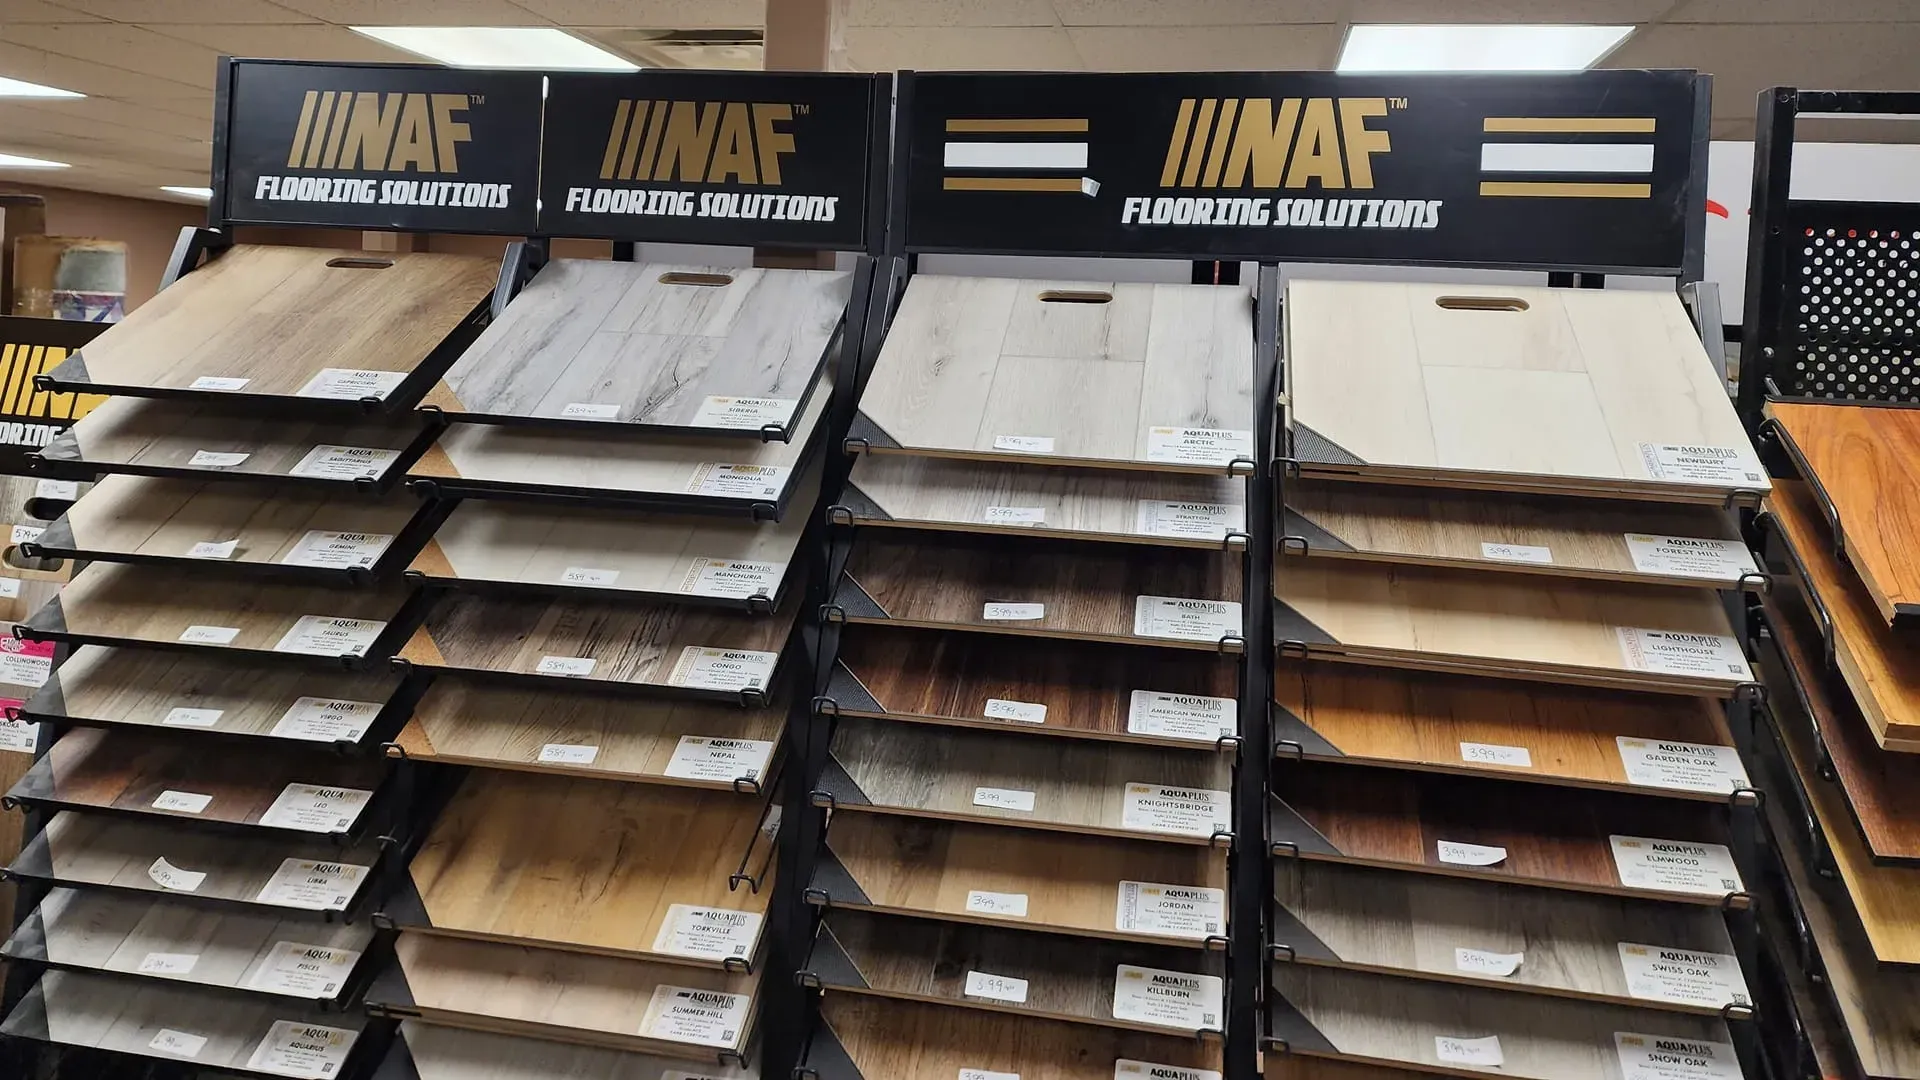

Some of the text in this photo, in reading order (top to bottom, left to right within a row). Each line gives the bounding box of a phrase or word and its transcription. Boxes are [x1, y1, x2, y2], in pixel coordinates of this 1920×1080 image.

[255, 176, 512, 209] FLOORING SOLUTIONS
[565, 188, 839, 222] FLOORING SOLUTIONS
[1121, 197, 1443, 228] FLOORING SOLUTIONS
[1677, 457, 1725, 465] NEWBURY
[718, 473, 762, 482] MONGOLIA
[1666, 539, 1724, 549] AQUAPLUS
[1656, 547, 1721, 558] FOREST HILL
[714, 571, 763, 581] MANCHURIA
[1665, 633, 1721, 648] AQUAPLUS
[1652, 645, 1715, 656] LIGHTHOUSE
[723, 652, 764, 662] AQUAPLUS
[711, 662, 742, 670] CONGO
[1173, 696, 1222, 711] AQUAPLUS
[1151, 708, 1221, 720] AMERICAN WALNUT
[710, 739, 753, 749] AQUAPLUS
[1658, 743, 1716, 756] AQUAPLUS
[710, 751, 736, 759] NEPAL
[1645, 753, 1717, 767] GARDEN OAK
[1159, 789, 1209, 801] AQUAPLUS
[1137, 799, 1214, 812] KNIGHTSBRIDGE
[1652, 843, 1707, 856] AQUAPLUS
[1646, 855, 1699, 866] ELMWOOD
[307, 877, 328, 885] LIBRA
[1164, 889, 1210, 900] AQUAPLUS
[1158, 901, 1194, 910] JORDAN
[704, 911, 747, 927] AQUAPLUS
[691, 924, 731, 935] YORKVILLE
[1660, 951, 1718, 966] AQUAPLUS
[297, 963, 321, 972] PISCES
[1652, 963, 1711, 978] SWISS OAK
[1152, 975, 1200, 989] AQUAPLUS
[1146, 986, 1190, 998] KILLBURN
[689, 991, 736, 1009] AQUAPLUS
[672, 1006, 724, 1019] SUMMER HILL
[288, 1041, 325, 1053] AQUARIUS
[1656, 1040, 1713, 1056] AQUAPLUS
[1648, 1053, 1708, 1068] SNOW OAK
